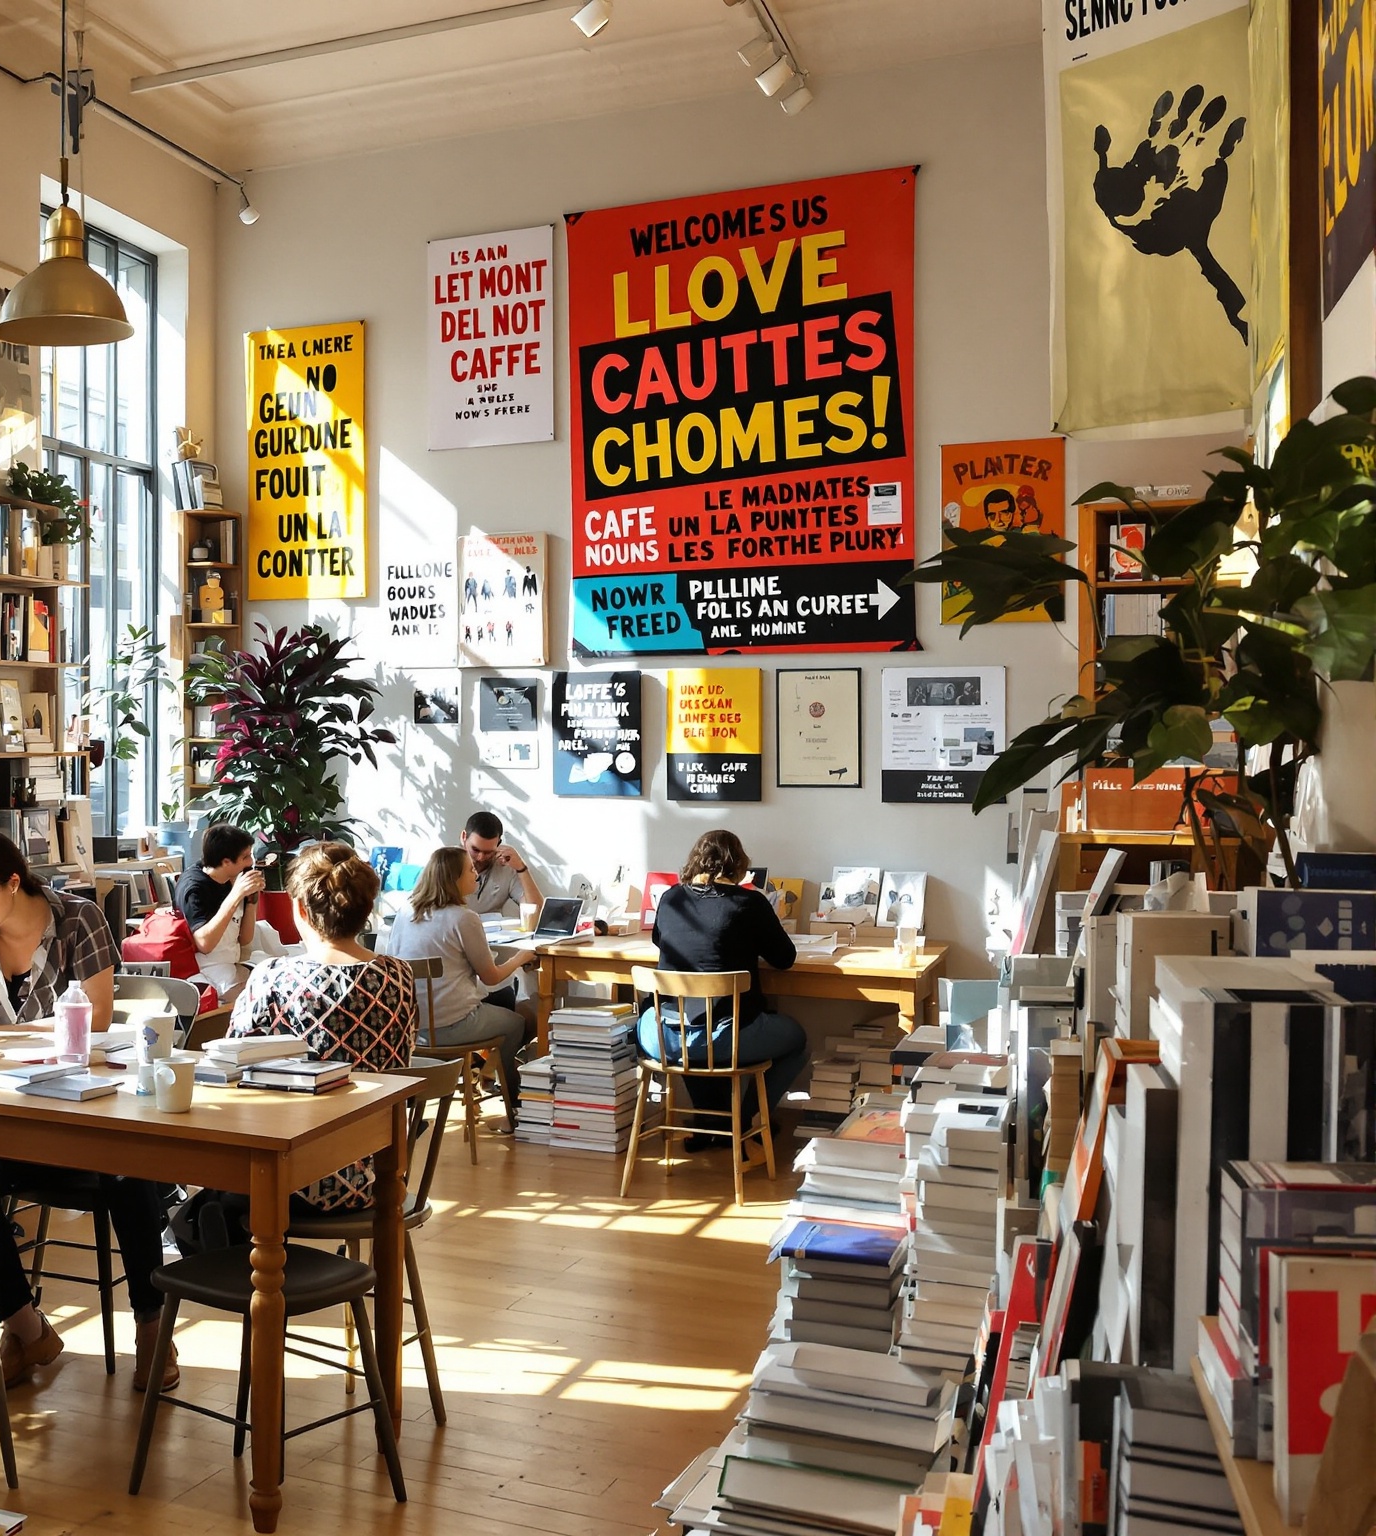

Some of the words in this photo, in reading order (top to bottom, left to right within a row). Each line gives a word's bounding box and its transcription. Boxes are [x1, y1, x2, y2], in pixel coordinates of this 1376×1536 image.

[434, 270, 473, 305] LET
[480, 259, 547, 299] MONT
[613, 230, 848, 339] LLOVE
[441, 308, 486, 343] DEL
[492, 299, 546, 337] NOT
[307, 364, 337, 392] NO
[450, 341, 541, 383] CAFFE
[591, 310, 886, 415] CAUTTES
[592, 375, 891, 488] CHOMES!
[705, 489, 734, 511] LE
[742, 476, 871, 508] MADNATES
[278, 513, 308, 543] UN
[317, 510, 342, 540] LA
[585, 506, 657, 542] CAFE
[669, 516, 699, 537] UN
[711, 513, 741, 535] LA
[257, 546, 355, 578] CONTTER
[585, 540, 660, 567] NOUNS
[669, 540, 715, 563] LES
[389, 603, 446, 622] WADUES
[592, 583, 664, 612] NOWR
[758, 599, 789, 618] AN
[796, 593, 869, 617] CUREE
[608, 611, 681, 640] FREED
